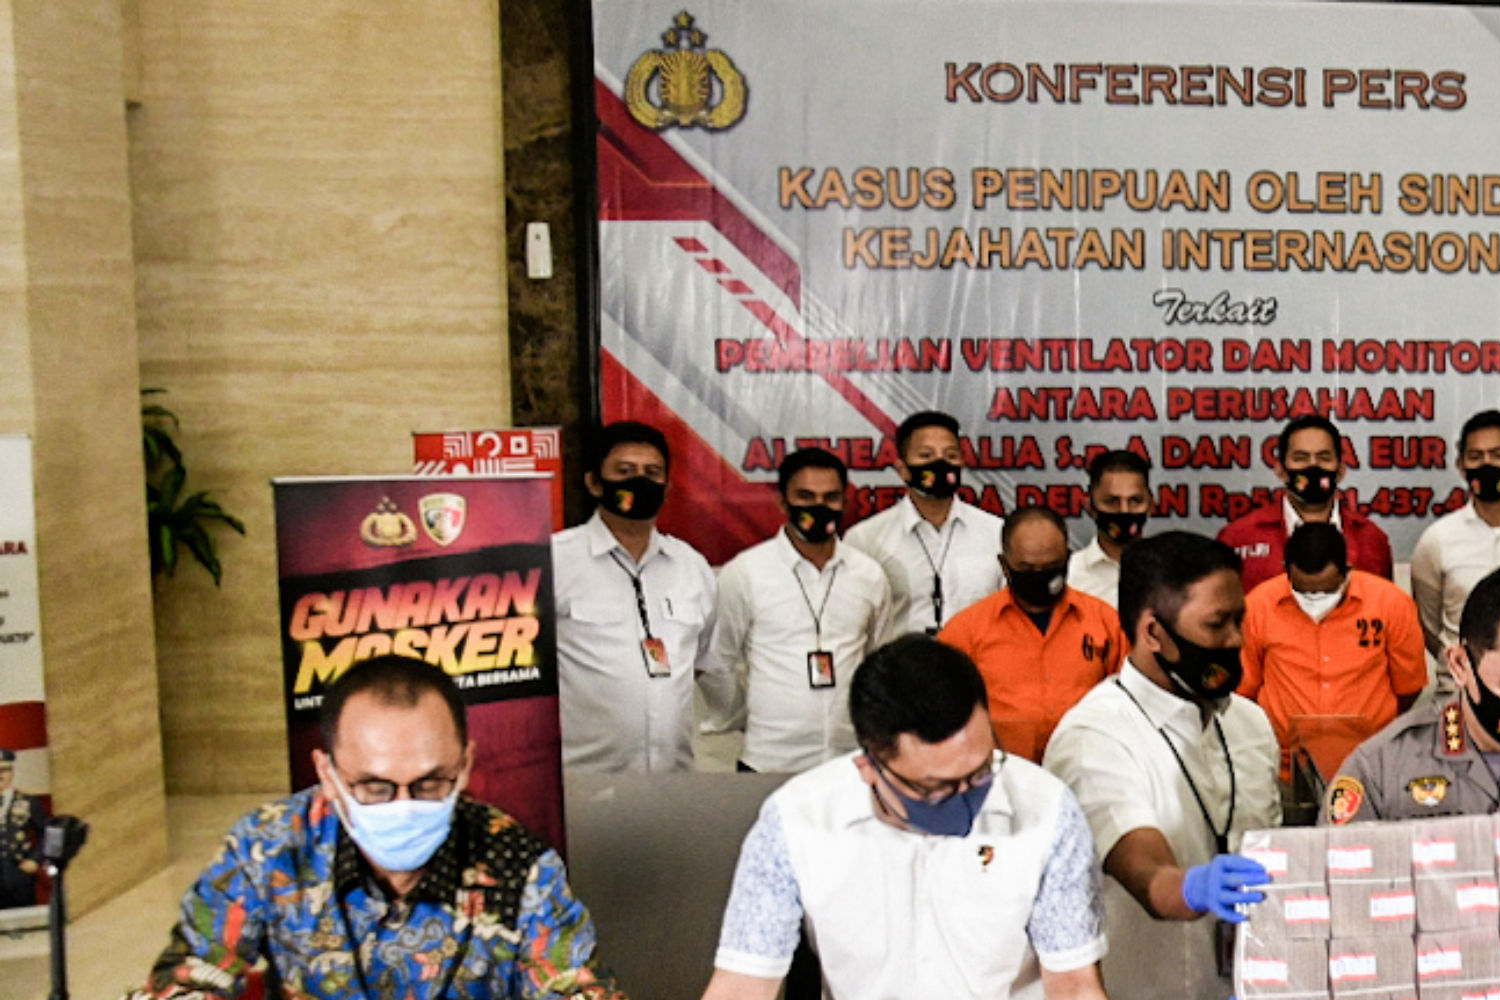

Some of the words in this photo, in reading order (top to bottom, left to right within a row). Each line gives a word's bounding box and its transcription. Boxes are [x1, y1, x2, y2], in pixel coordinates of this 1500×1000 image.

[944, 62, 1307, 108] KONFERENSI
[1323, 68, 1467, 110] PERS
[777, 166, 955, 210] KASUS
[972, 169, 1231, 212] PENIPUAN
[1246, 172, 1383, 214] OLEH
[843, 227, 1145, 270] KEJAHATAN
[1153, 288, 1277, 325] Terkait
[715, 338, 951, 373] PEMBELIAN
[960, 337, 1213, 373] VENTILATOR
[1222, 339, 1311, 373] DAN
[987, 386, 1158, 421] ANTARA
[1167, 386, 1434, 421] PERUSAHAAN
[1161, 435, 1252, 469] DAN
[1369, 435, 1447, 470] EUR
[290, 569, 541, 641] GUNAKAN
